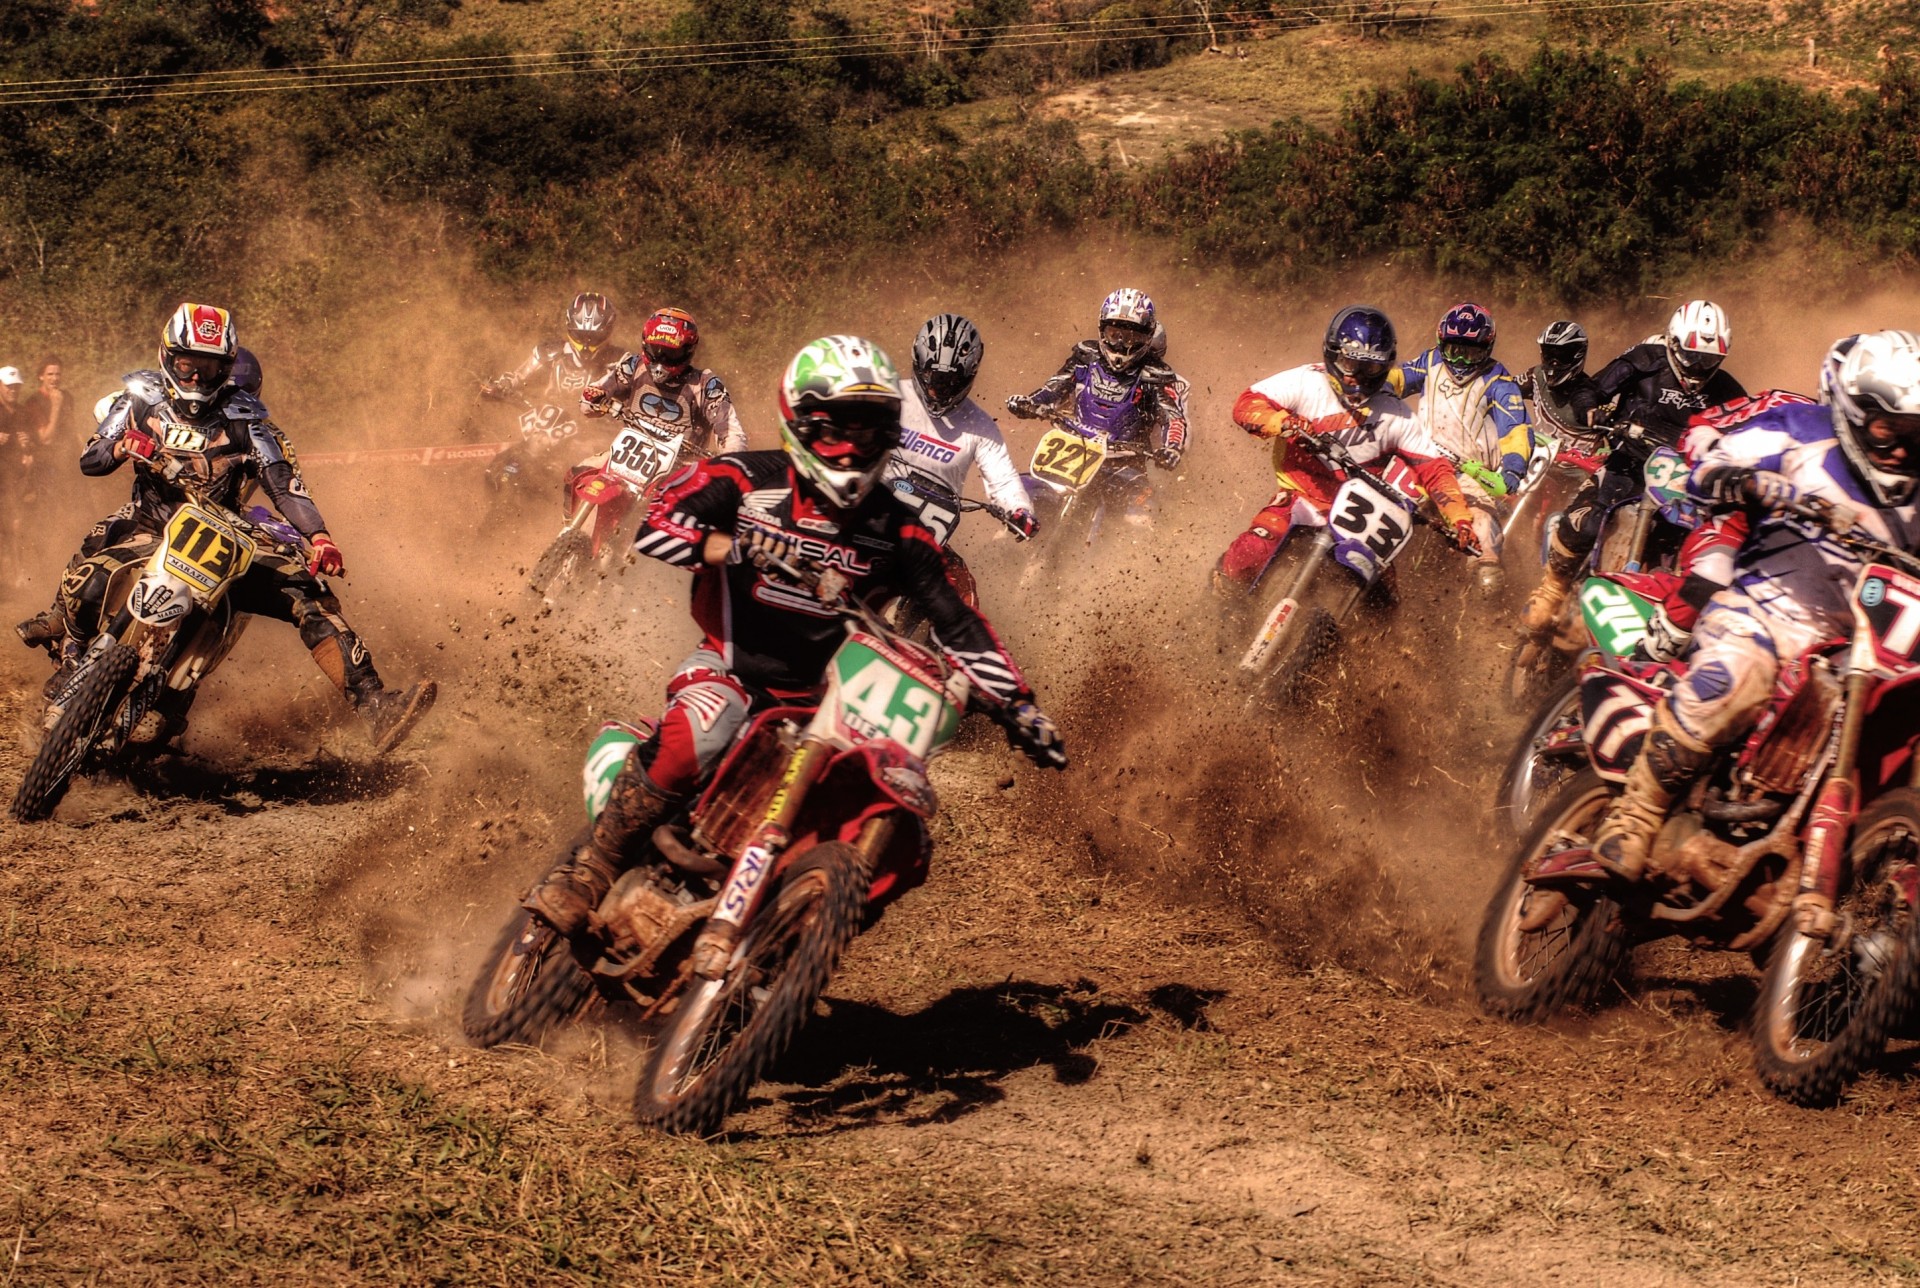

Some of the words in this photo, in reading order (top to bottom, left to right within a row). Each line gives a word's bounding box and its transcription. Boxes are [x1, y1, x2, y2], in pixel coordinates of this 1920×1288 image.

[520, 405, 578, 440] 598
[447, 448, 497, 460] HONDA
[612, 435, 668, 479] 355
[1034, 437, 1101, 477] 327
[738, 505, 782, 527] HONDA
[1333, 491, 1404, 560] 33
[170, 517, 244, 580] 113
[171, 558, 209, 585] MARAZIL
[841, 658, 942, 761] 43
[725, 850, 767, 919] IRIS
